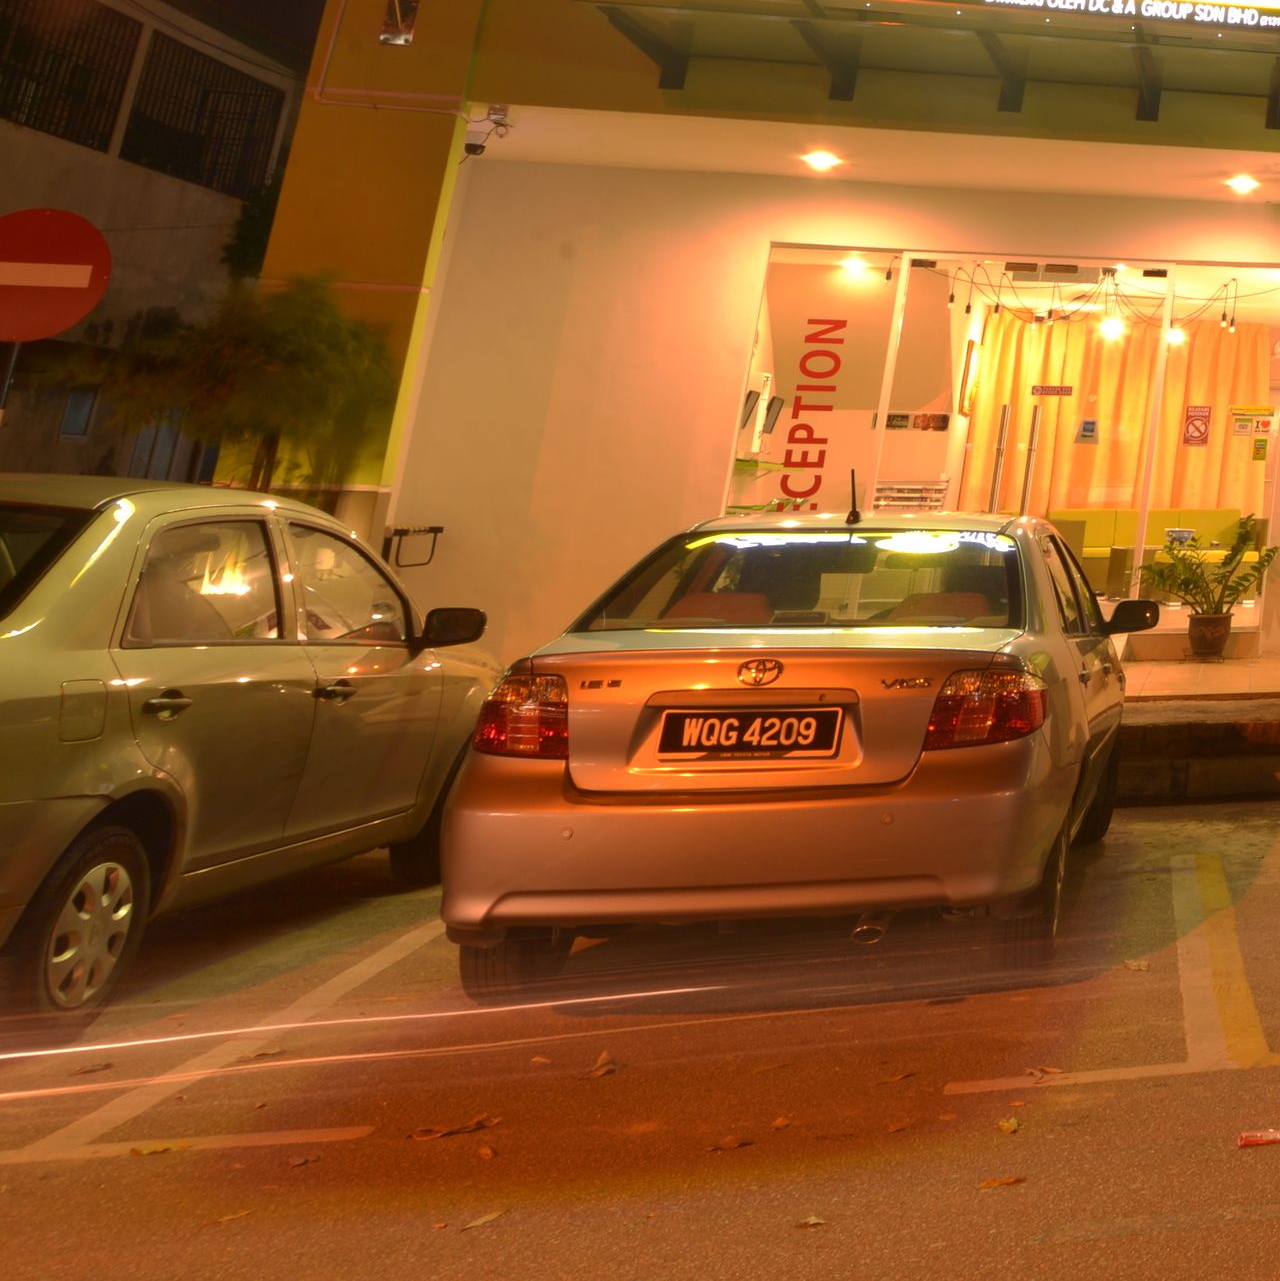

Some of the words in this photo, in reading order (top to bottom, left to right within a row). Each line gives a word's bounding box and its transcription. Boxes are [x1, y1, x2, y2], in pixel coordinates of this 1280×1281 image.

[1194, 4, 1226, 23] SDN
[1227, 7, 1260, 26] BHD
[776, 318, 849, 513] CEPTION
[682, 717, 739, 747] WQG
[742, 717, 818, 747] 4209
